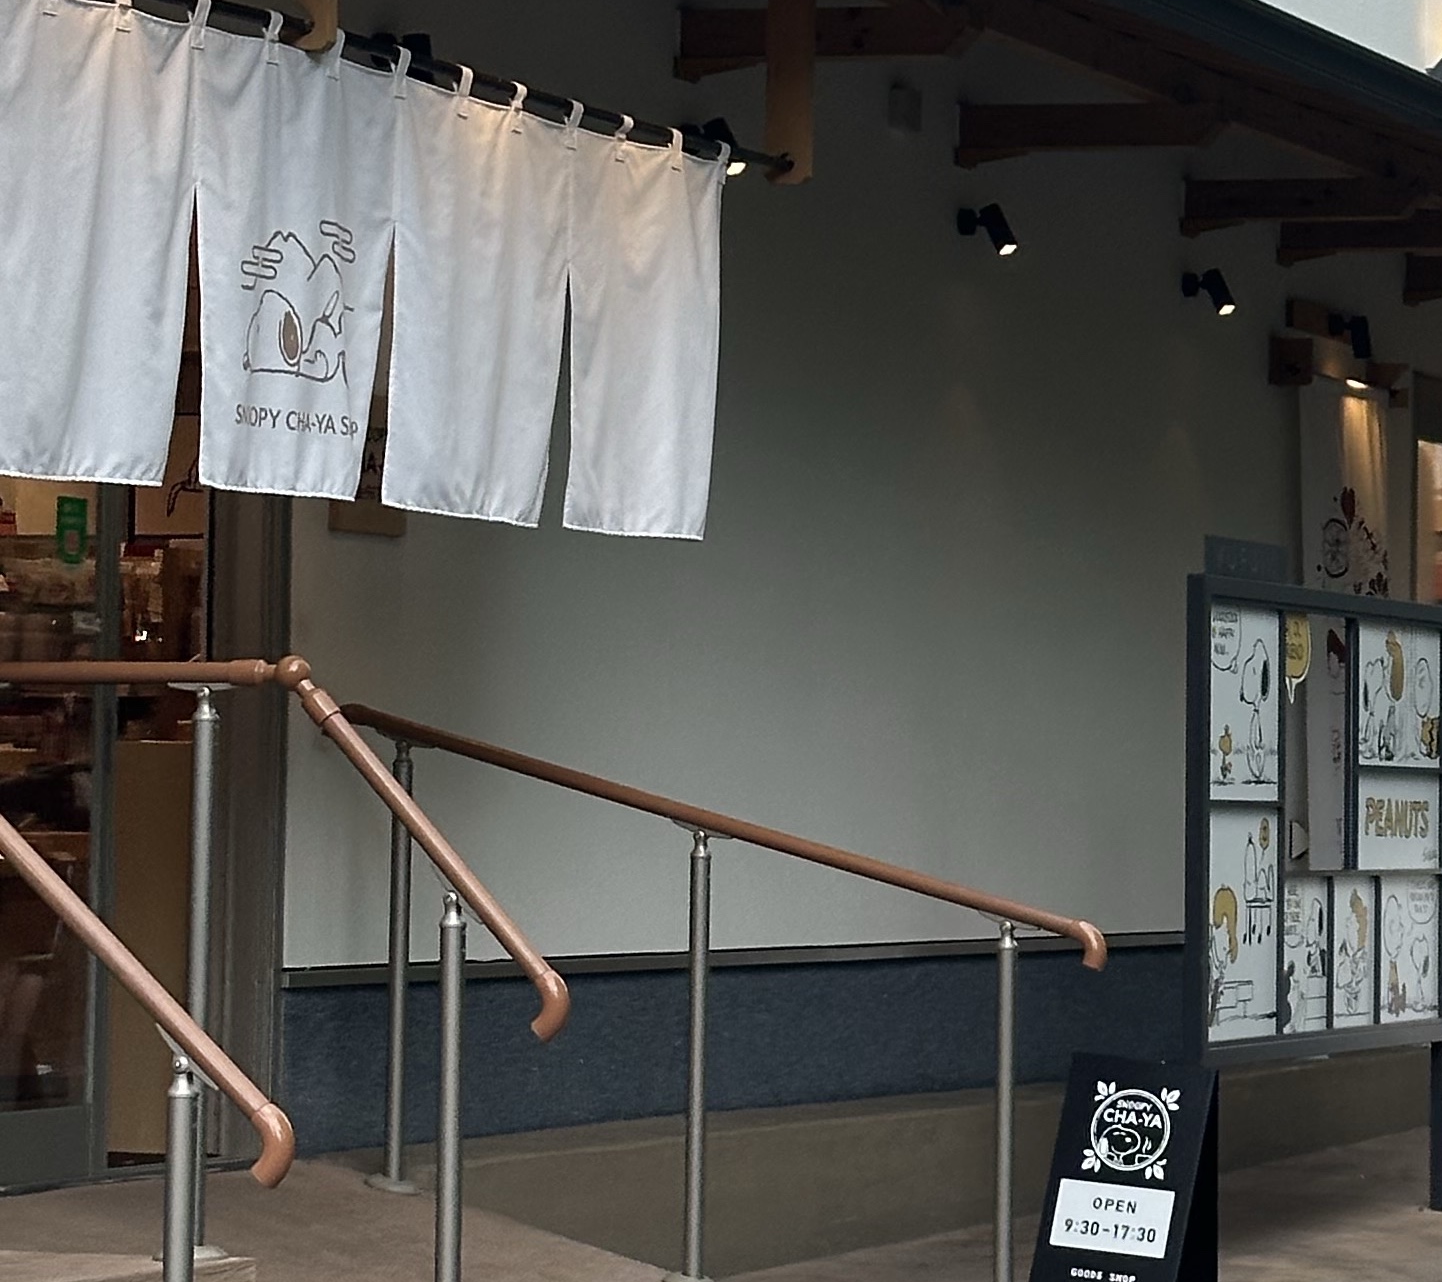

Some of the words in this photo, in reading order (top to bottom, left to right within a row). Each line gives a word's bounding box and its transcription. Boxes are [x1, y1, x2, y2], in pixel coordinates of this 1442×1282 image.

[1364, 797, 1429, 839] PEANUTS
[1103, 1108, 1163, 1129] CHA-YA
[1092, 1197, 1137, 1214] OPEN
[1070, 1268, 1103, 1281] GOODS
